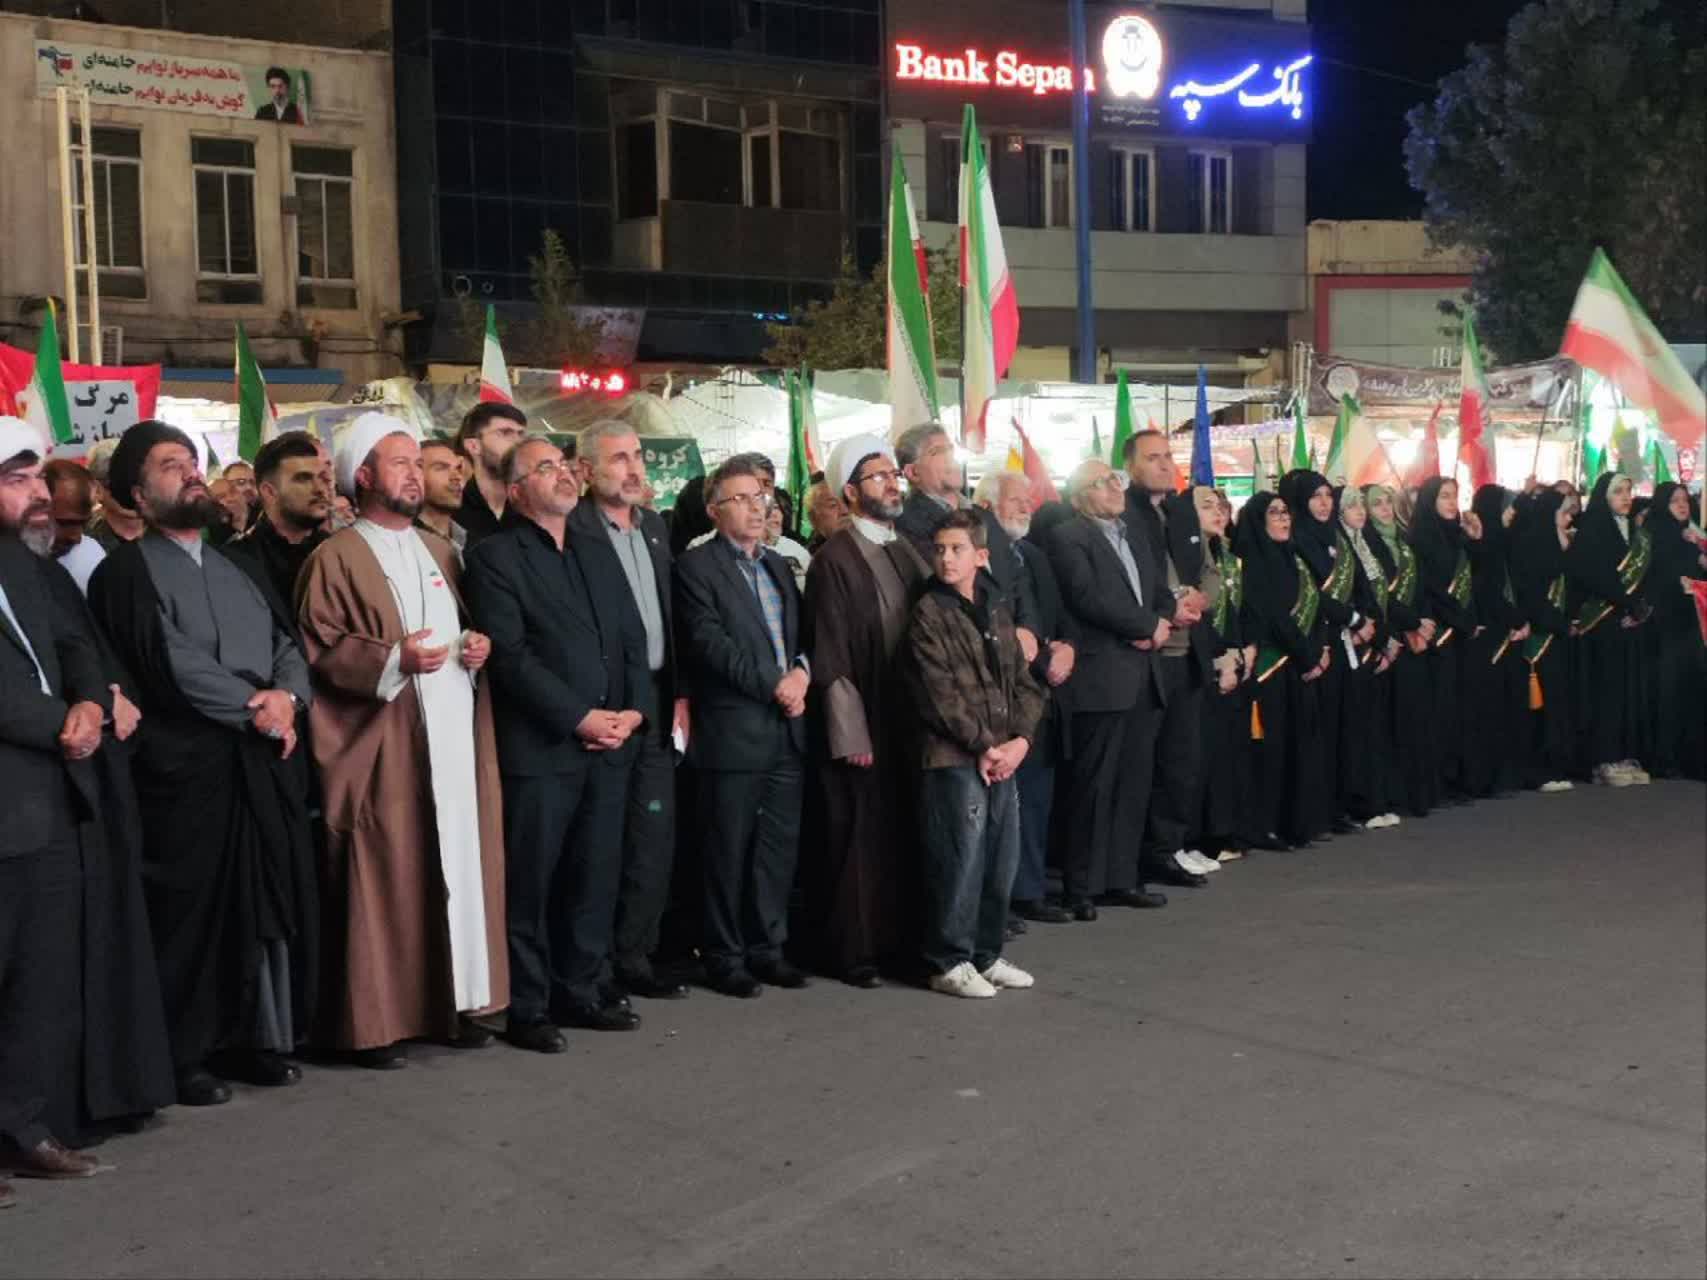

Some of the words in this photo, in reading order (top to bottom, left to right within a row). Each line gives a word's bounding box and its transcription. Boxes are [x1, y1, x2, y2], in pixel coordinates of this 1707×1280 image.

[895, 43, 990, 84] Bank
[1169, 63, 1260, 120] سپه
[1238, 55, 1313, 119] بانک
[74, 384, 129, 414] مرگ
[645, 443, 691, 469] گروه
